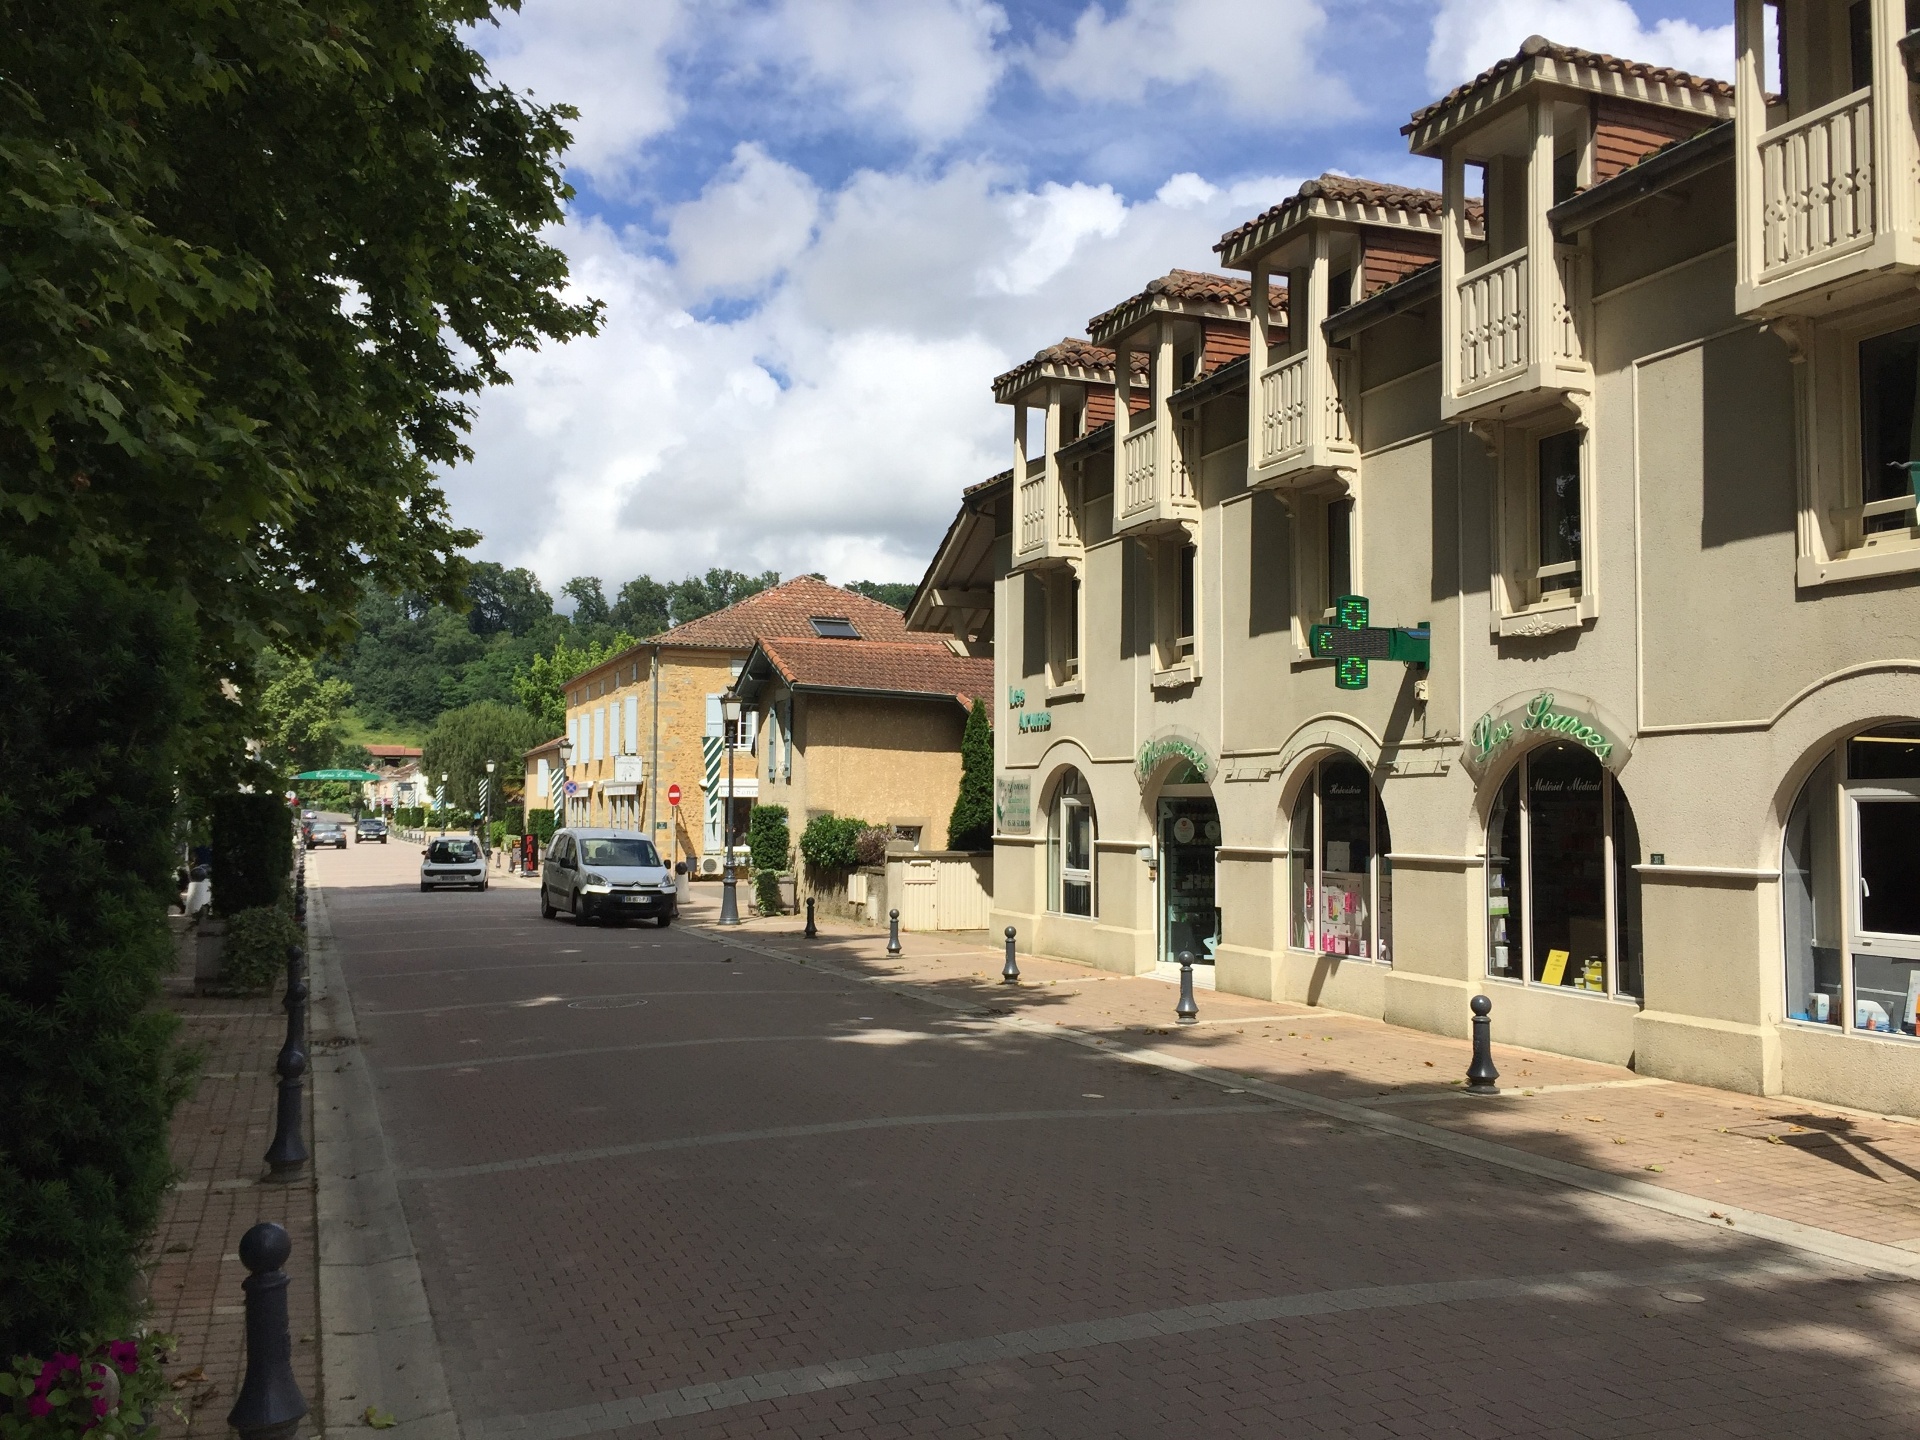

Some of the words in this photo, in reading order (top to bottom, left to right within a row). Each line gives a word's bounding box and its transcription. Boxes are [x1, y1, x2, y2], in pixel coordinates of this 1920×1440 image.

[1471, 714, 1513, 762] Les
[1521, 693, 1613, 758] Sources
[1530, 777, 1564, 791] Matériel
[1567, 777, 1602, 791] Médical
[526, 835, 534, 870] PAIN
